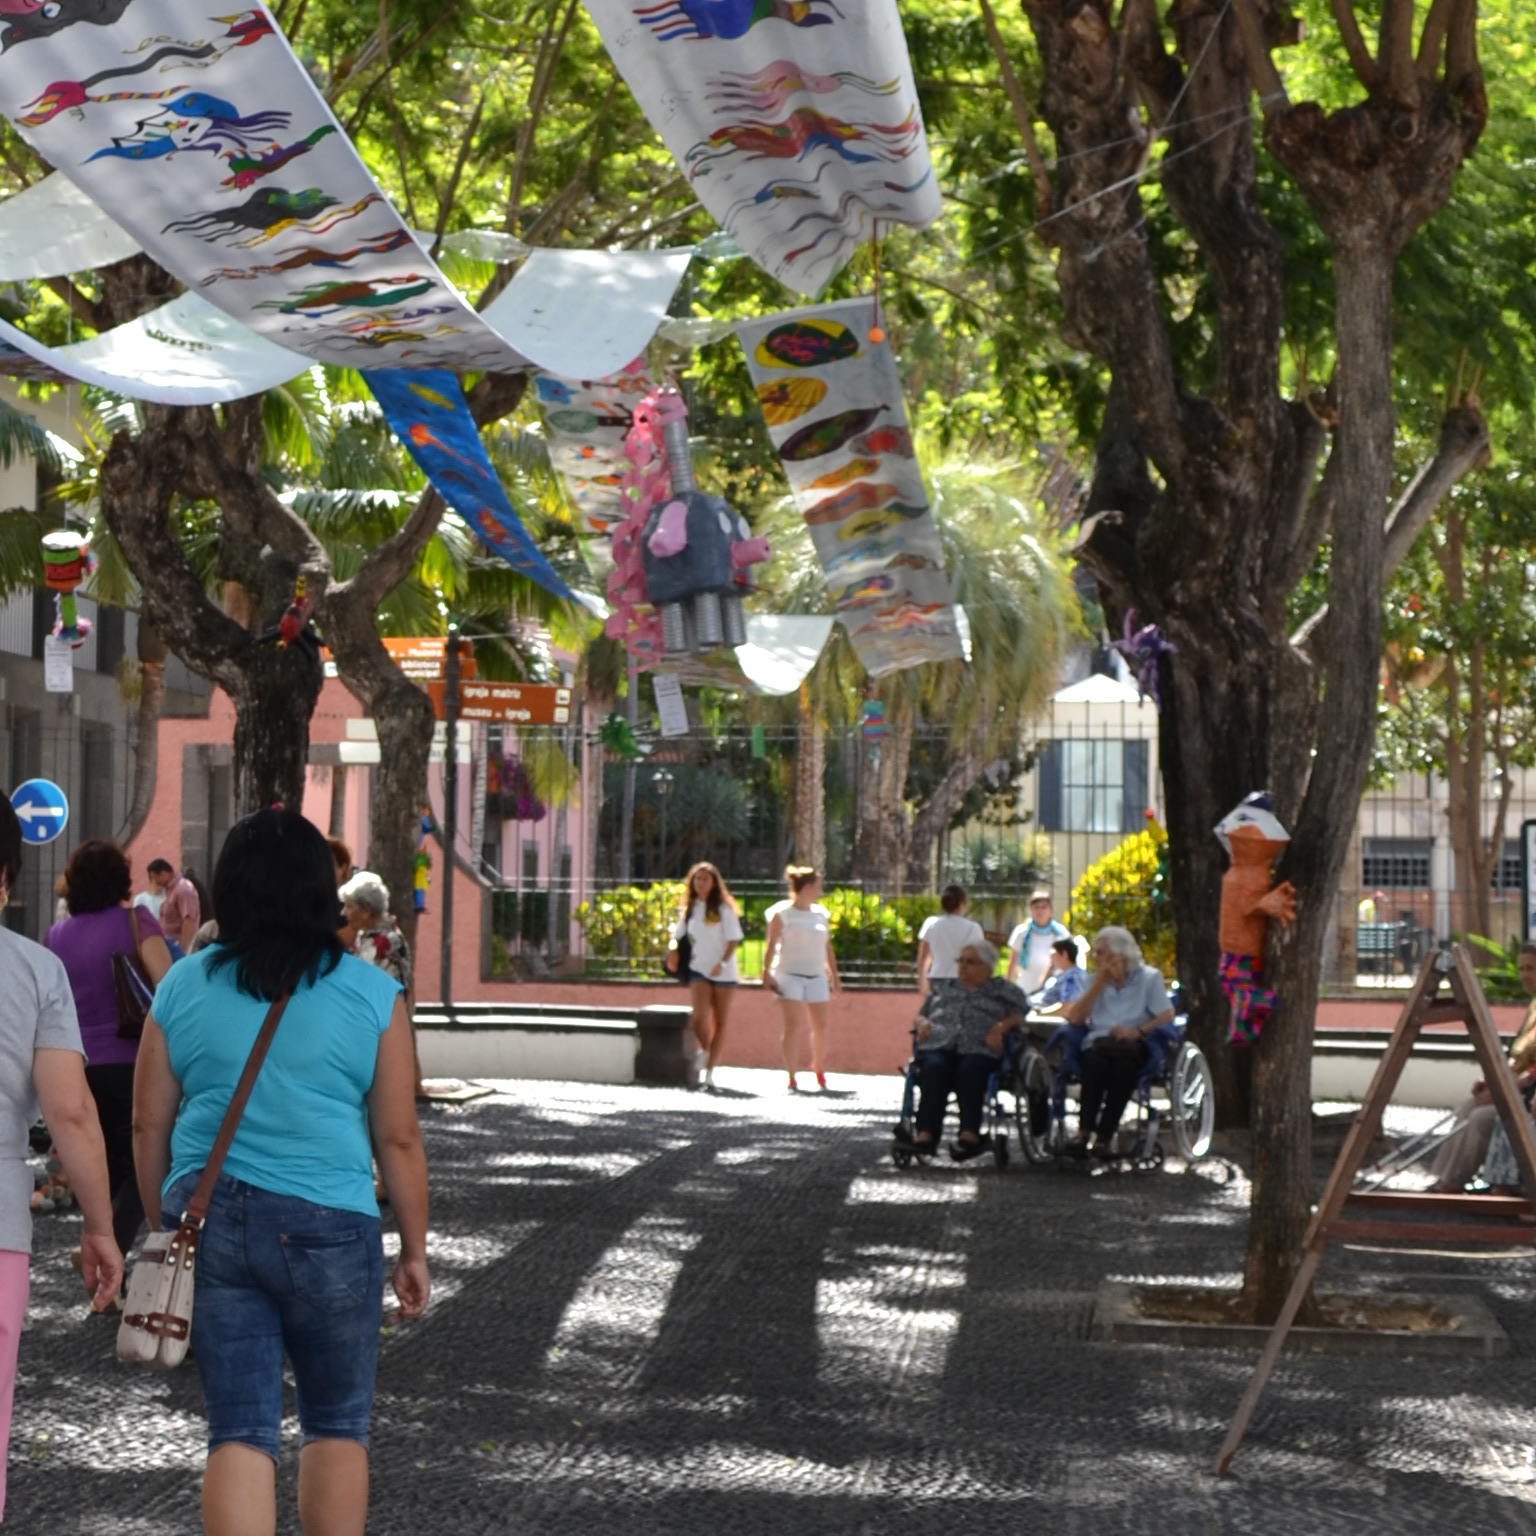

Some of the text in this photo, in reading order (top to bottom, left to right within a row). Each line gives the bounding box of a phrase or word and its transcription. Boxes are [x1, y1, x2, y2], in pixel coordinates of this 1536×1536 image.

[409, 648, 442, 657] Madeira
[401, 660, 440, 669] biblioteca
[464, 686, 521, 700] igreja matriz
[462, 708, 492, 718] museu
[505, 707, 531, 721] igreja
